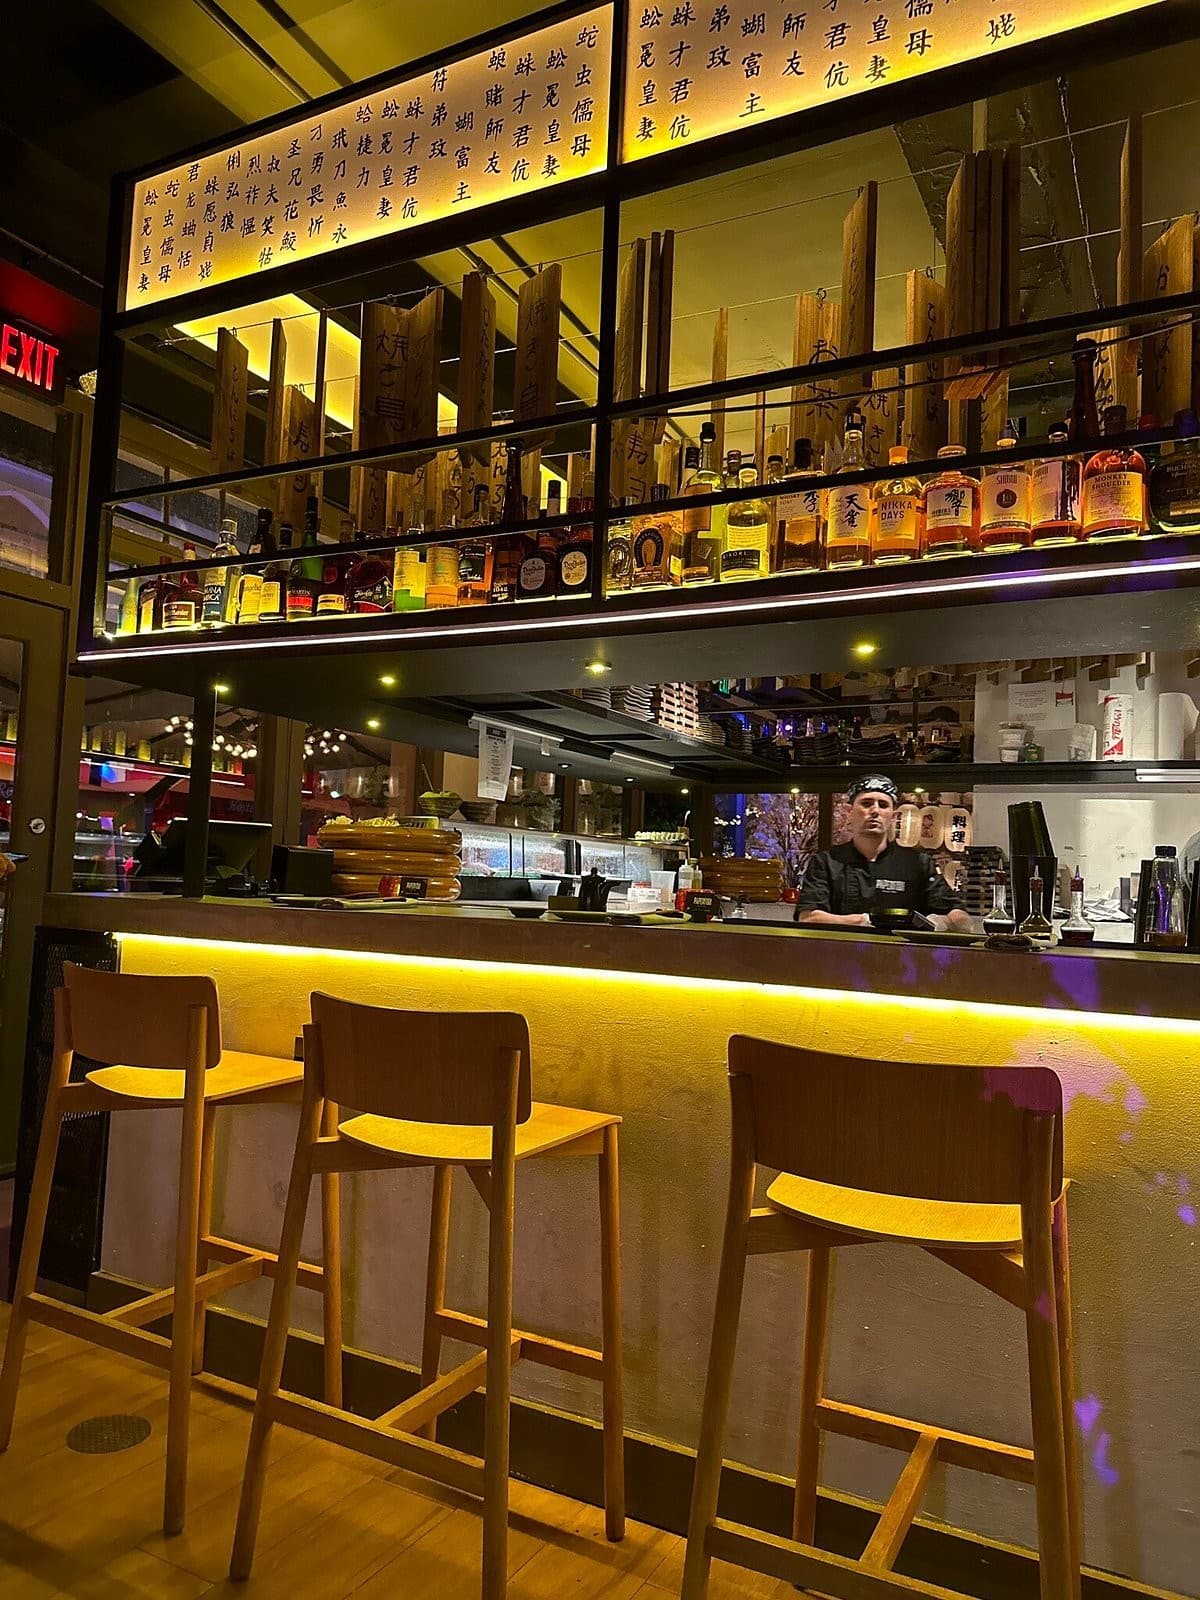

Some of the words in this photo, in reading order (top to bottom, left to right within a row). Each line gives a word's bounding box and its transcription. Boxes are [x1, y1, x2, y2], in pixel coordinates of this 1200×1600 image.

[0, 323, 59, 391] EXIT
[1094, 473, 1128, 483] MONKEY
[1092, 480, 1131, 491] SHOULDER
[881, 500, 912, 511] NIKKA
[881, 510, 905, 521] DAYS
